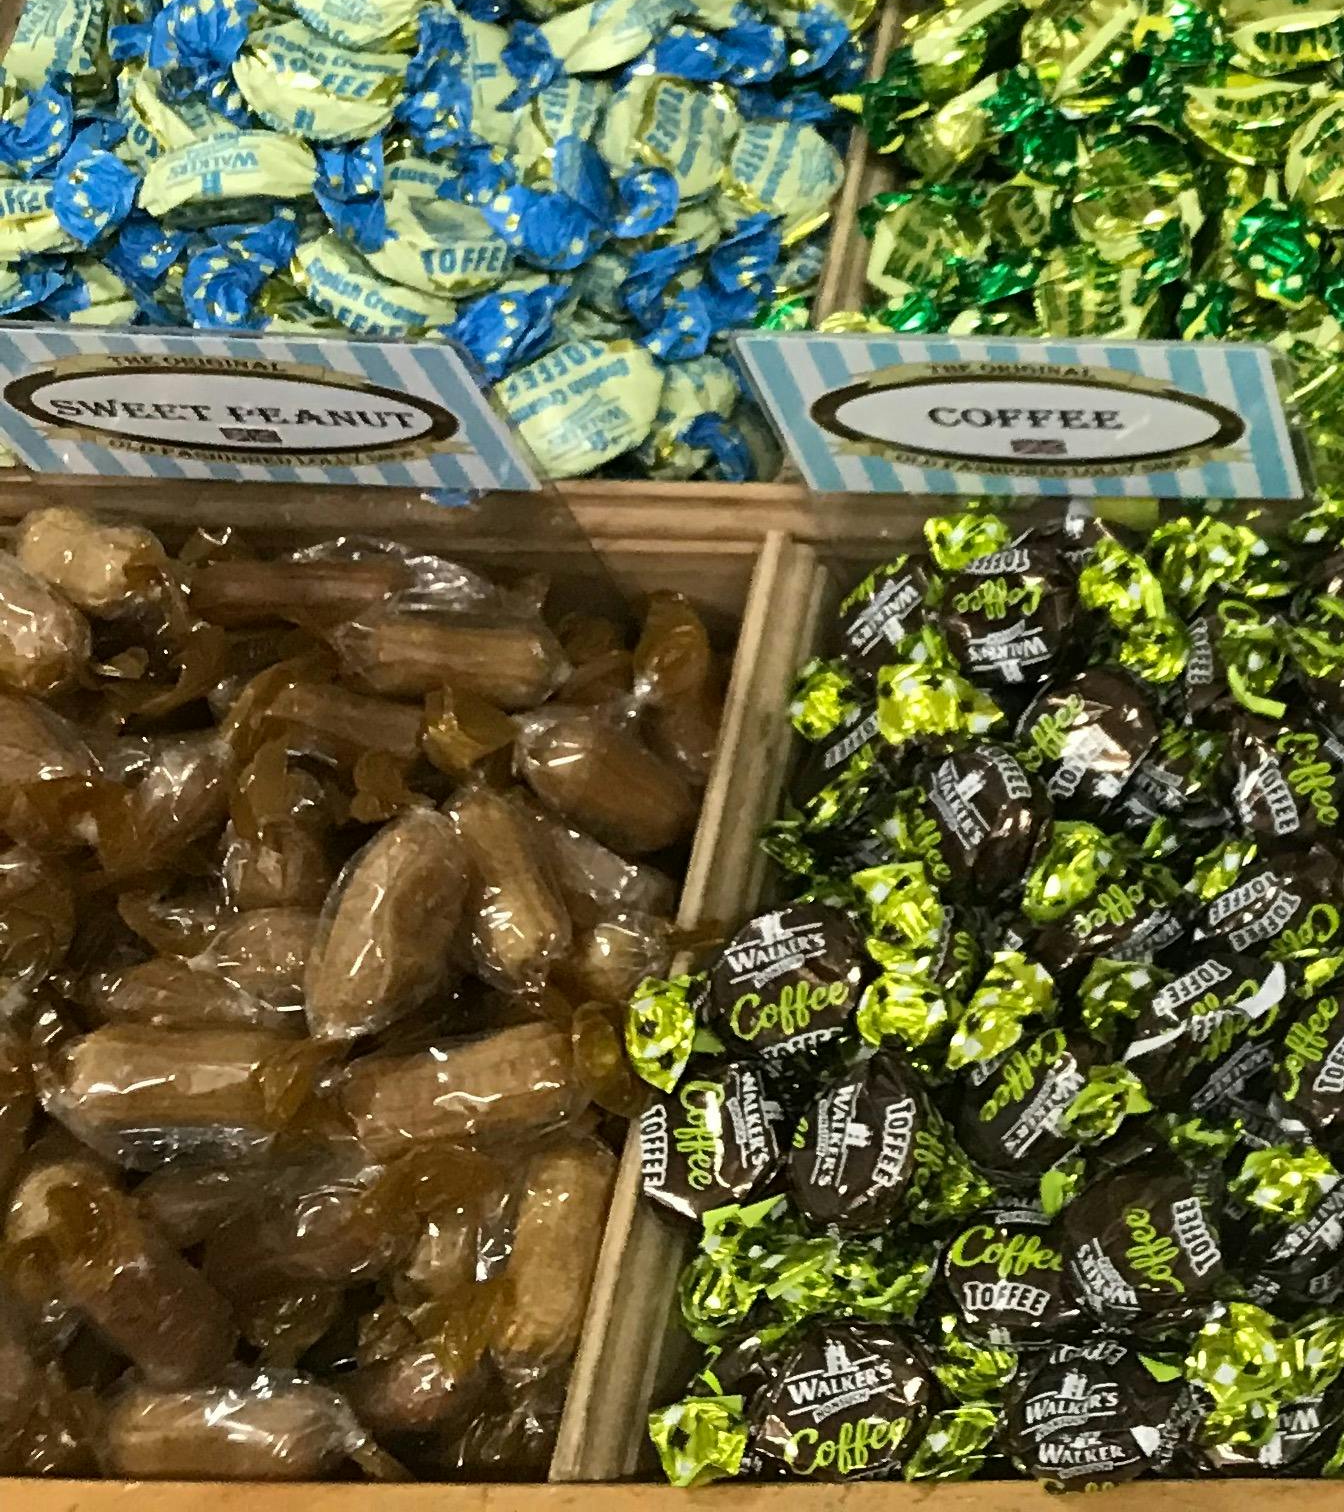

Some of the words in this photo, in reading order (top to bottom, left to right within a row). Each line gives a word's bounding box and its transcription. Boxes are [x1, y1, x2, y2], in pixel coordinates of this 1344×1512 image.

[49, 399, 212, 421] SWEET
[927, 406, 1126, 430] COFFEE
[953, 574, 1042, 620] Coffee
[1276, 732, 1340, 826] Coffee
[725, 932, 826, 973] WALKER'S
[729, 980, 850, 1041] Coffee
[641, 1104, 668, 1188] TOFFEE
[673, 1081, 724, 1190] Coffee
[741, 1075, 771, 1168] WALKER'S
[872, 1097, 916, 1188] TOFFEE
[962, 1281, 1050, 1316] TOFFEE
[786, 1362, 893, 1406] WALKER'S
[790, 1416, 912, 1474] Coffee
